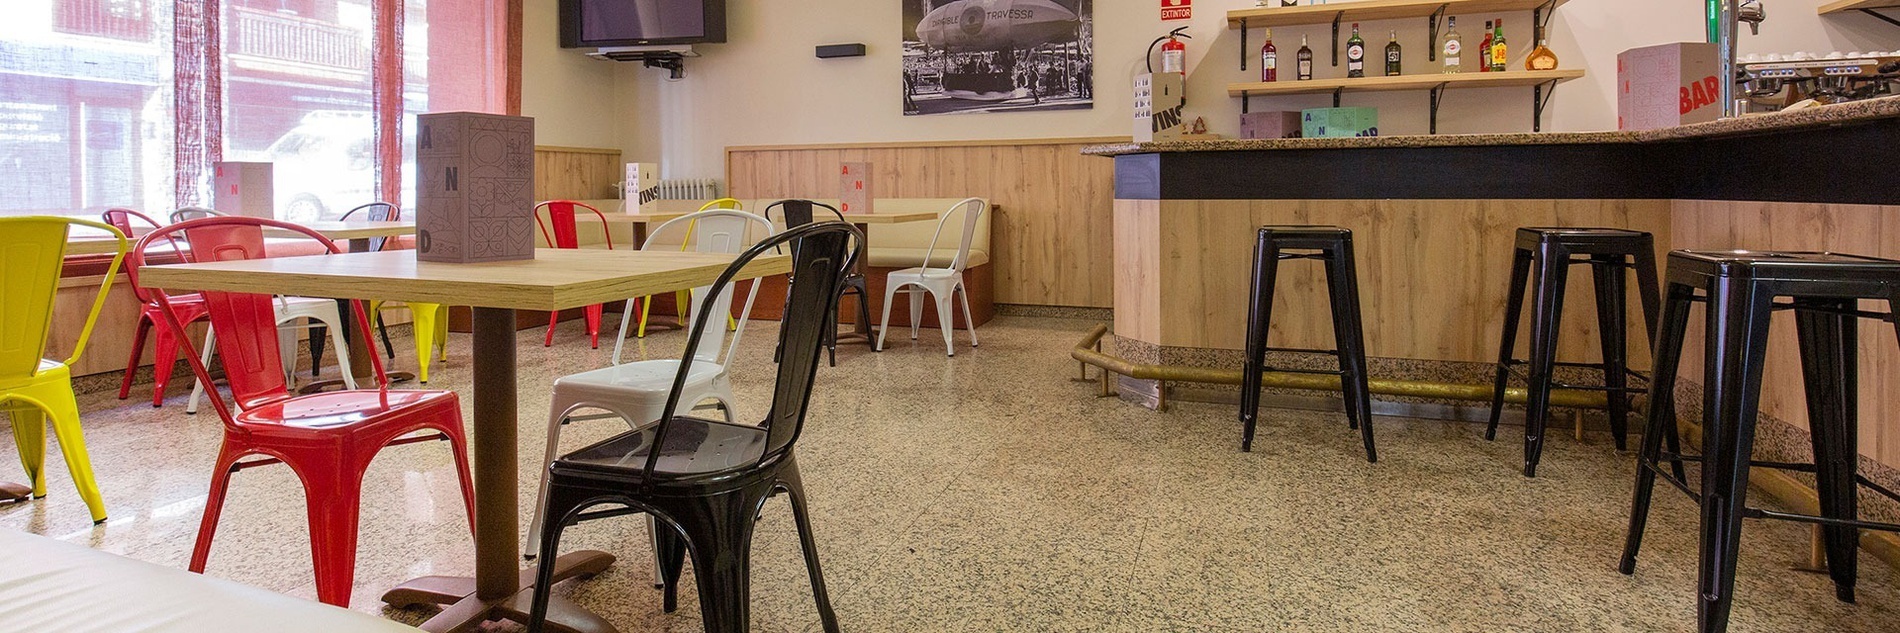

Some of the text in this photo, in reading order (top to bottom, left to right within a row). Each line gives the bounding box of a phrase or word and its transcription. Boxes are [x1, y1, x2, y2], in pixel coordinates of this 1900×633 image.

[986, 9, 1034, 20] TRAVESSA
[1162, 9, 1191, 19] EXTINTOR
[1679, 75, 1719, 116] BAR
[1305, 113, 1312, 122] A
[1319, 126, 1325, 135] N
[420, 125, 432, 149] A
[216, 165, 224, 178] A
[841, 165, 849, 175] A
[445, 166, 458, 191] N
[231, 184, 238, 195] N
[855, 180, 863, 190] N
[841, 202, 849, 212] D
[420, 229, 432, 254] D
